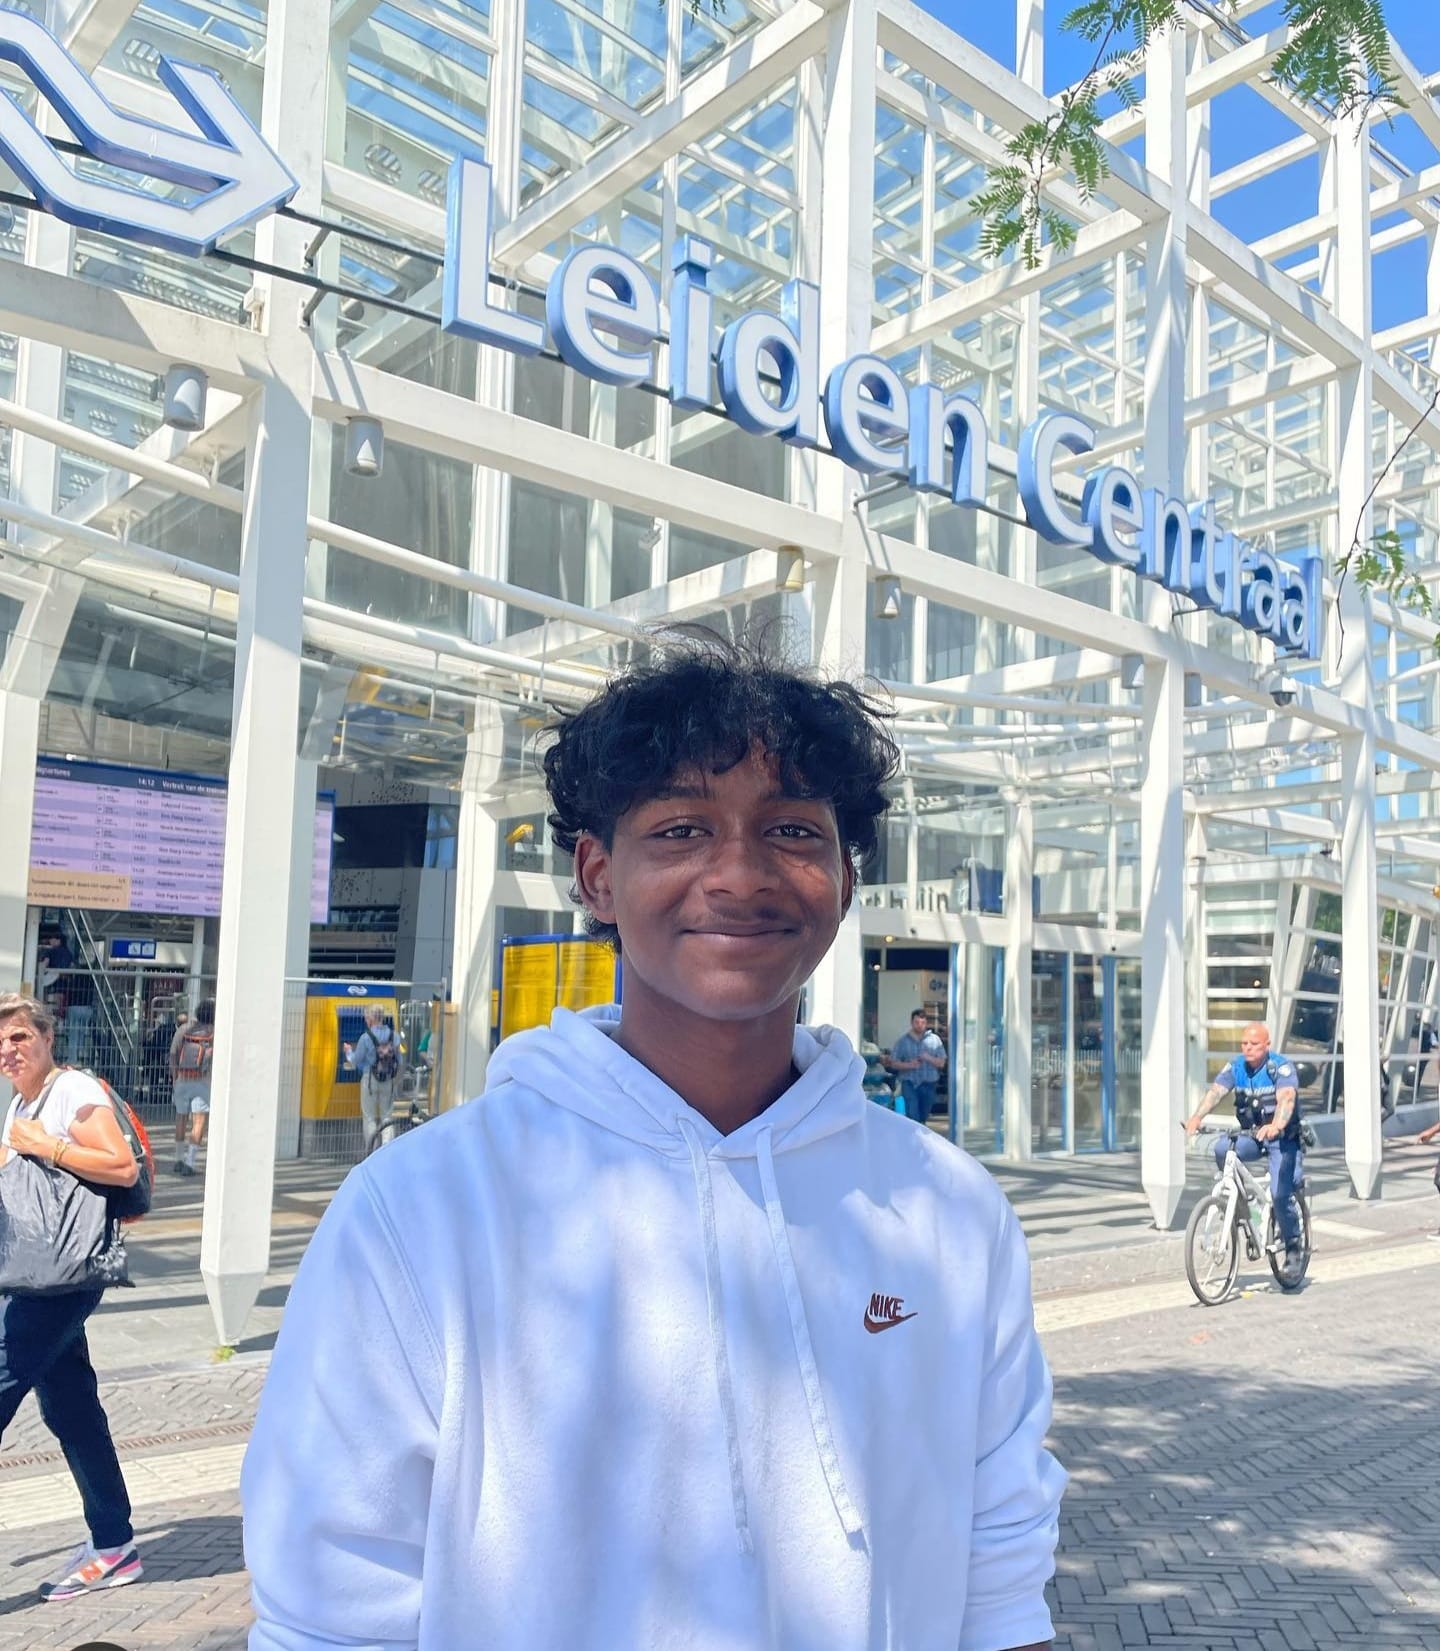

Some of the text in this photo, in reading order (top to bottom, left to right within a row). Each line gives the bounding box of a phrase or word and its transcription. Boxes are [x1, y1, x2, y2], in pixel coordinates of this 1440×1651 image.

[442, 154, 1323, 660] Leiden Centraal
[869, 1292, 904, 1320] NIKE
